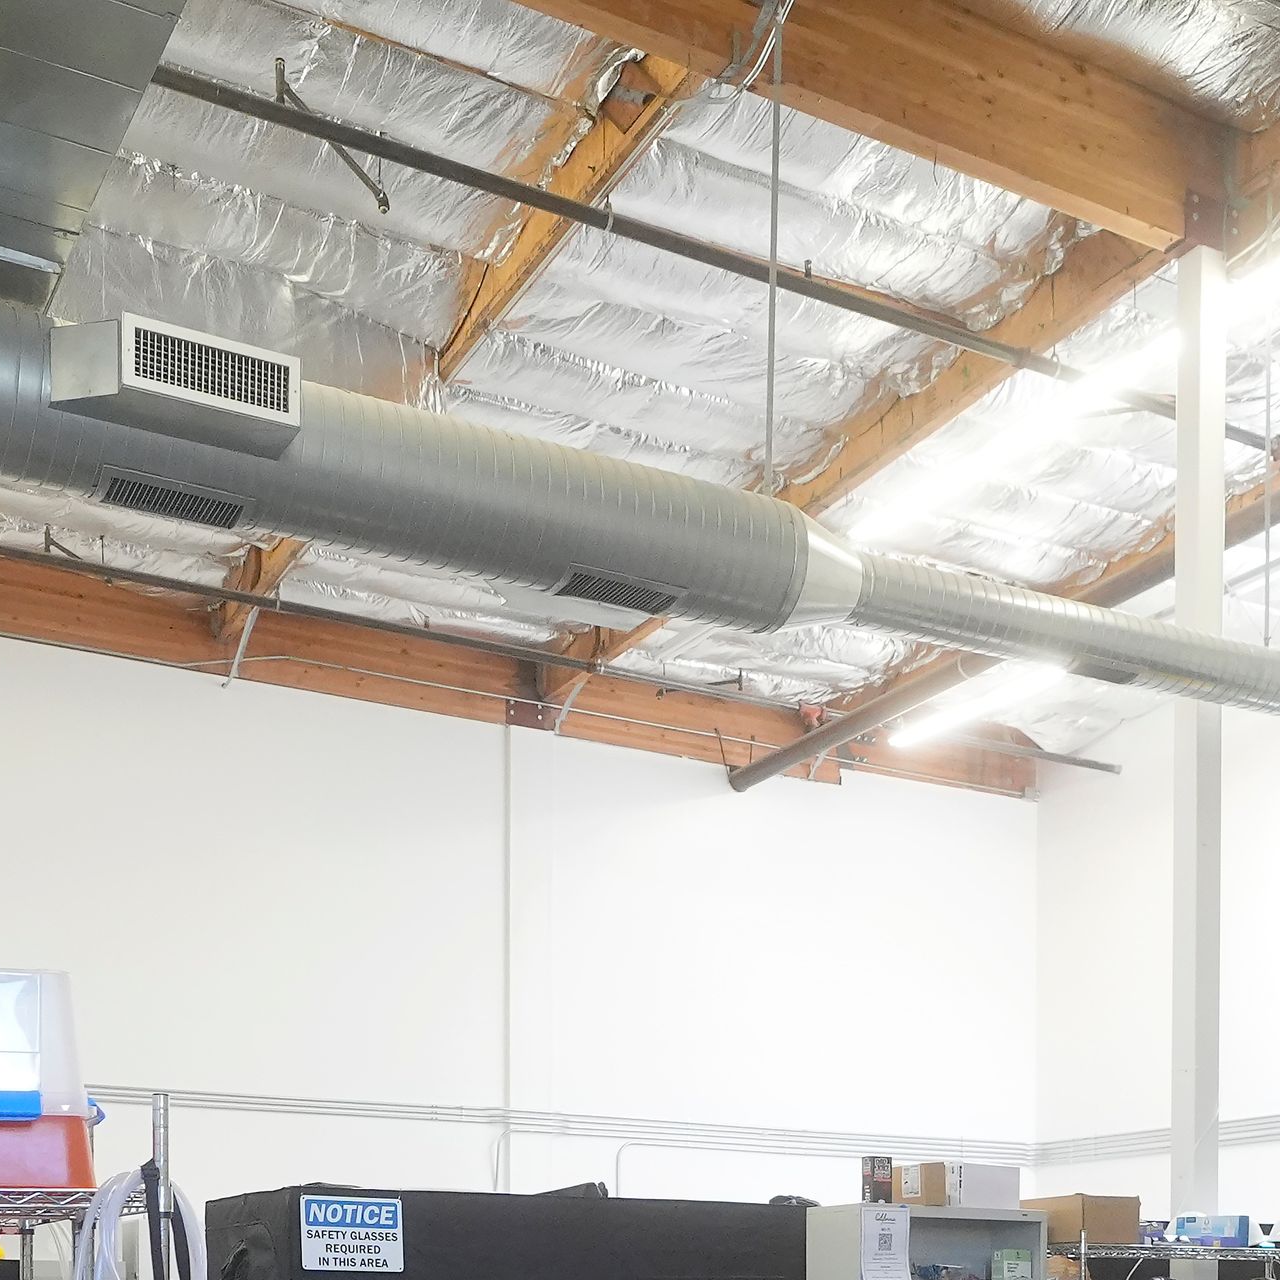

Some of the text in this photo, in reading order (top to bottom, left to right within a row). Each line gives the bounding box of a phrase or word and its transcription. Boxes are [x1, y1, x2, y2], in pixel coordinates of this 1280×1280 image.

[309, 1203, 395, 1225] NOTICE
[306, 1229, 398, 1242] SAFETY GLASSES
[325, 1243, 381, 1255] REQUIRED
[318, 1257, 389, 1268] IN THIS AREA
